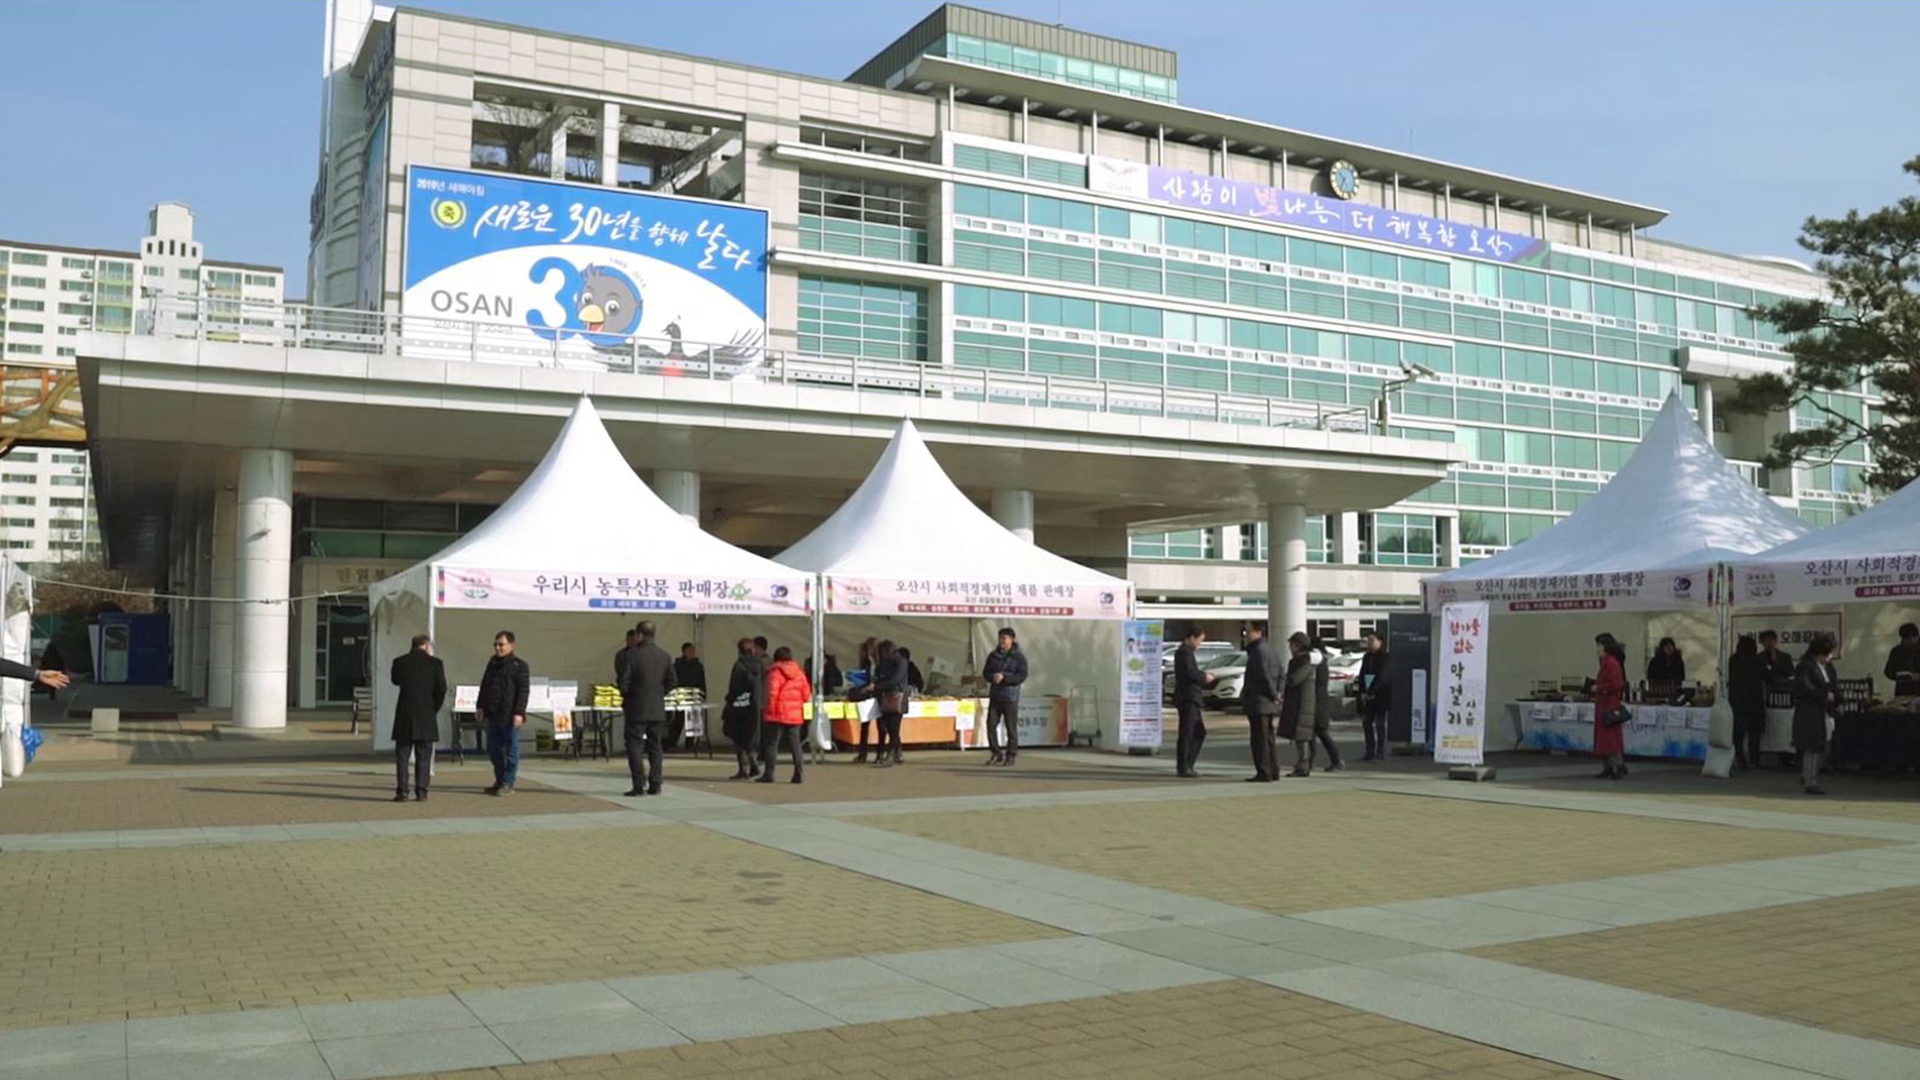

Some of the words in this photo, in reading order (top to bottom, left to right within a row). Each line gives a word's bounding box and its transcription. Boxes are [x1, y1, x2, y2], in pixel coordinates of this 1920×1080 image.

[1162, 176, 1237, 205] 사람이
[1249, 187, 1340, 224] 빛나는
[1351, 211, 1374, 231] 더
[1387, 216, 1456, 247] 행복한
[1469, 229, 1512, 256] 오산
[473, 200, 557, 237] 새로운
[559, 202, 643, 243] 30년을
[648, 221, 689, 246] 향해
[696, 219, 751, 270] 날다
[431, 289, 513, 318] OSAN
[1804, 559, 1848, 577] 오산시
[1855, 553, 1920, 574] 사회적경
[533, 575, 586, 596] 우리시
[596, 577, 669, 598] 농특산물
[678, 579, 730, 599] 판매장
[895, 580, 931, 595] 오산시
[935, 581, 1012, 597] 사회적경제기업
[1016, 584, 1038, 597] 제품
[1043, 584, 1075, 598] 판매장
[1475, 577, 1503, 593] 오산시
[1509, 574, 1579, 592] 사회적경제기업
[1583, 573, 1604, 589] 제품
[1610, 571, 1645, 588] 판매장
[1453, 639, 1475, 655] 없는
